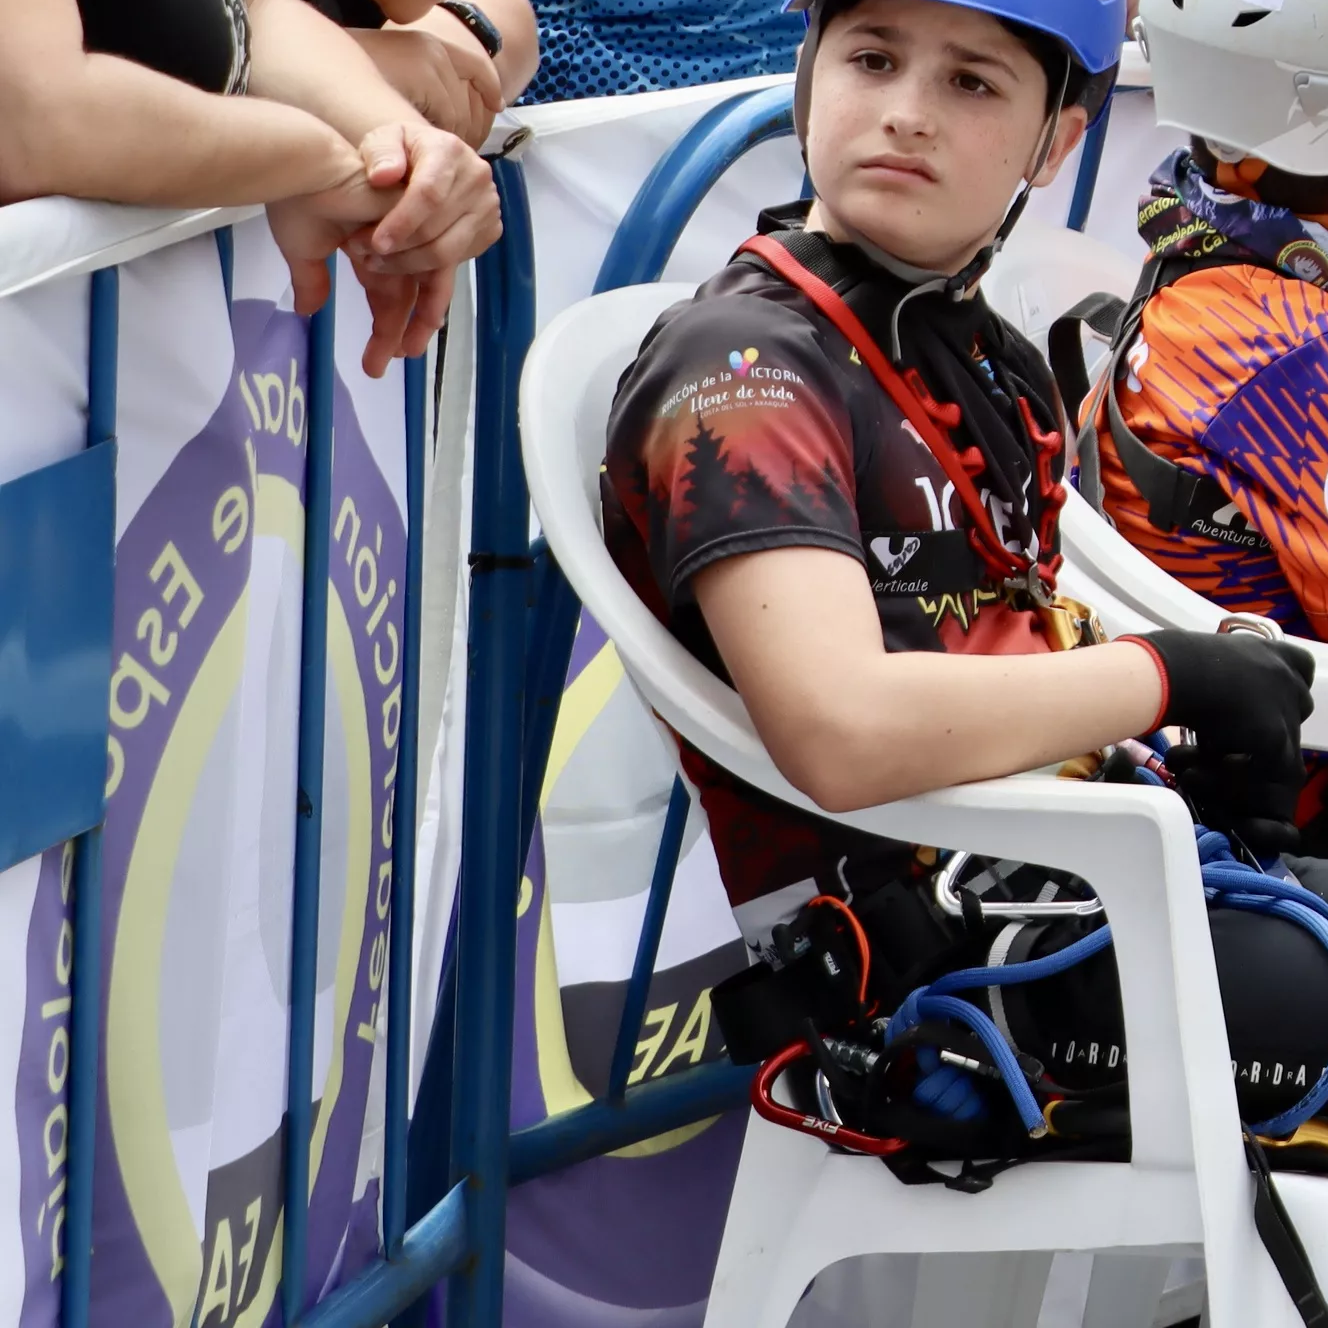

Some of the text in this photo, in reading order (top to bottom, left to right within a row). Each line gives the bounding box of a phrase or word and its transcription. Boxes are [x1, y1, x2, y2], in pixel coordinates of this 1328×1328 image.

[661, 380, 699, 415] RINCÓN
[702, 375, 717, 389] de
[719, 371, 732, 382] la
[746, 383, 767, 399] de
[771, 384, 806, 402] vida
[721, 404, 735, 414] DEL
[735, 402, 748, 411] SOL
[1190, 518, 1257, 546] Aventure
[803, 1115, 839, 1134] FIXE
